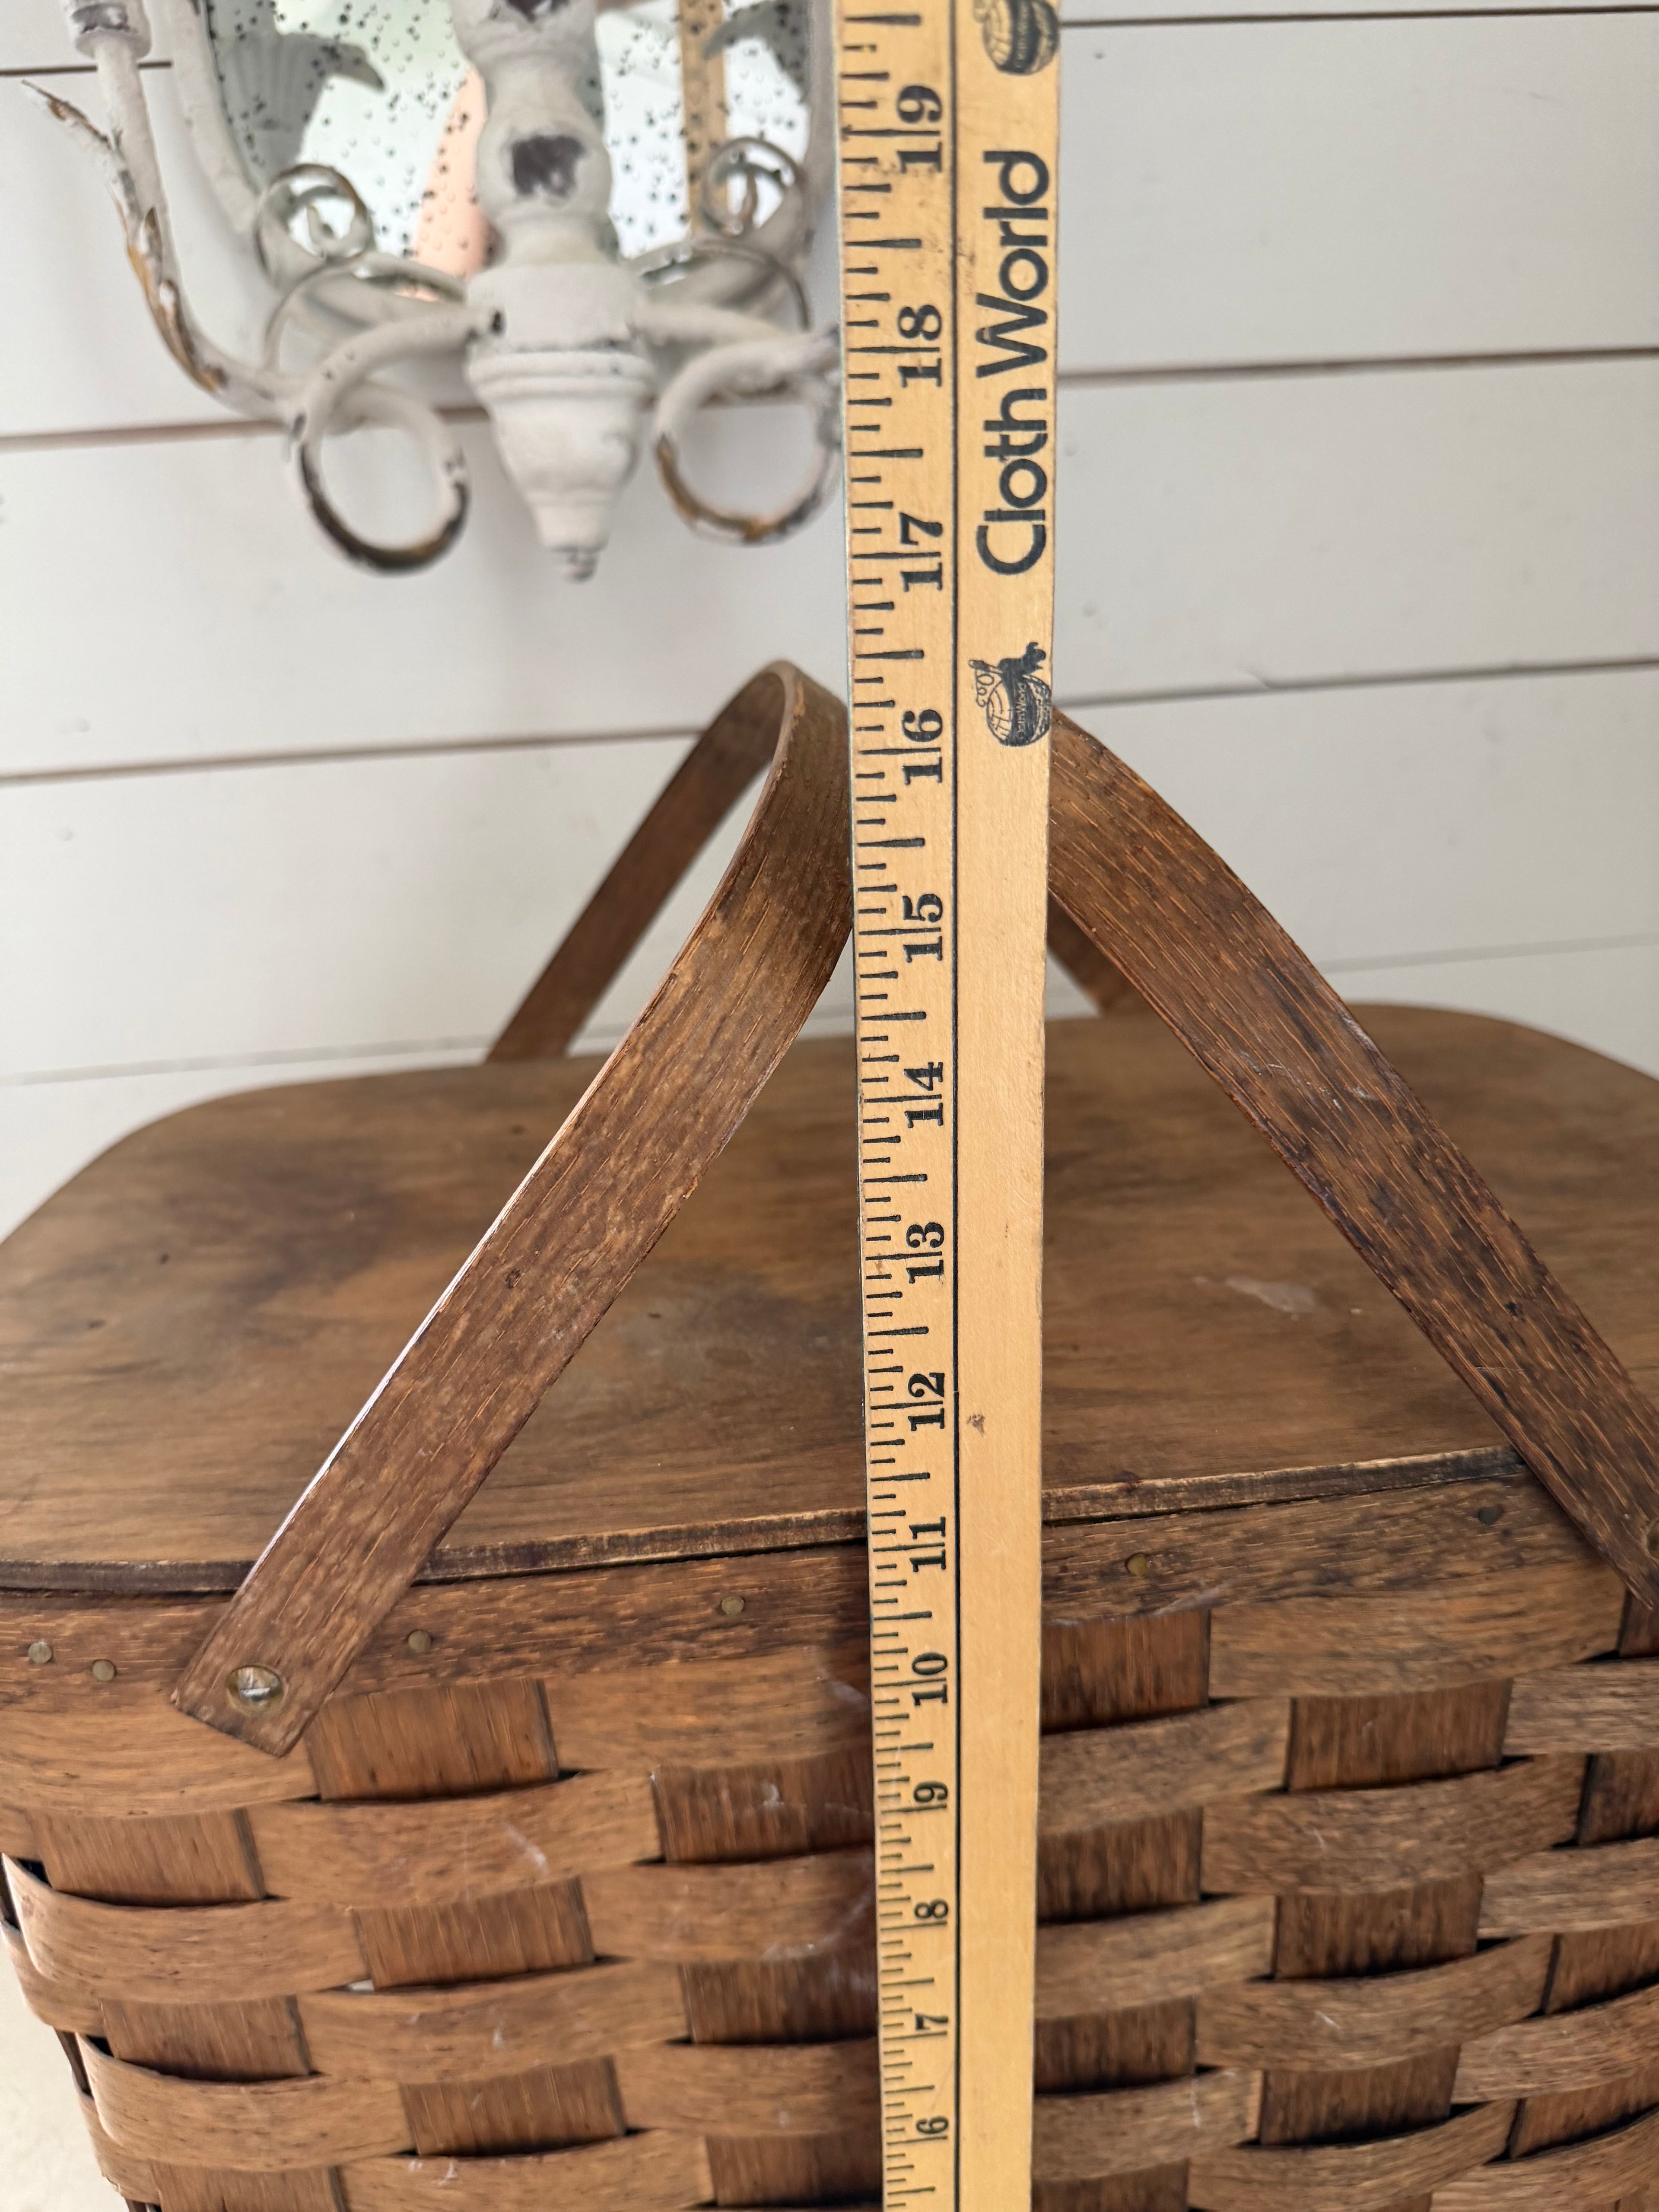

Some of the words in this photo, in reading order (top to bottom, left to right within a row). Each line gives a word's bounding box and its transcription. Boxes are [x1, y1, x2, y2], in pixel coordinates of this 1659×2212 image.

[897, 85, 942, 174] 19
[976, 151, 1049, 378] World
[898, 304, 942, 388] 18
[976, 388, 1048, 575] Cloth
[899, 512, 943, 592] 17
[902, 709, 943, 785] 16
[902, 893, 943, 963] 15
[903, 1062, 944, 1128] 14
[906, 1222, 944, 1284] 13
[908, 1372, 945, 1432] 12
[909, 1516, 947, 1573] 11
[912, 1653, 948, 1707] 10
[913, 1781, 948, 1804] 9
[914, 1899, 949, 1920] 8
[915, 2012, 948, 2032] 7
[916, 2116, 949, 2135] 6
